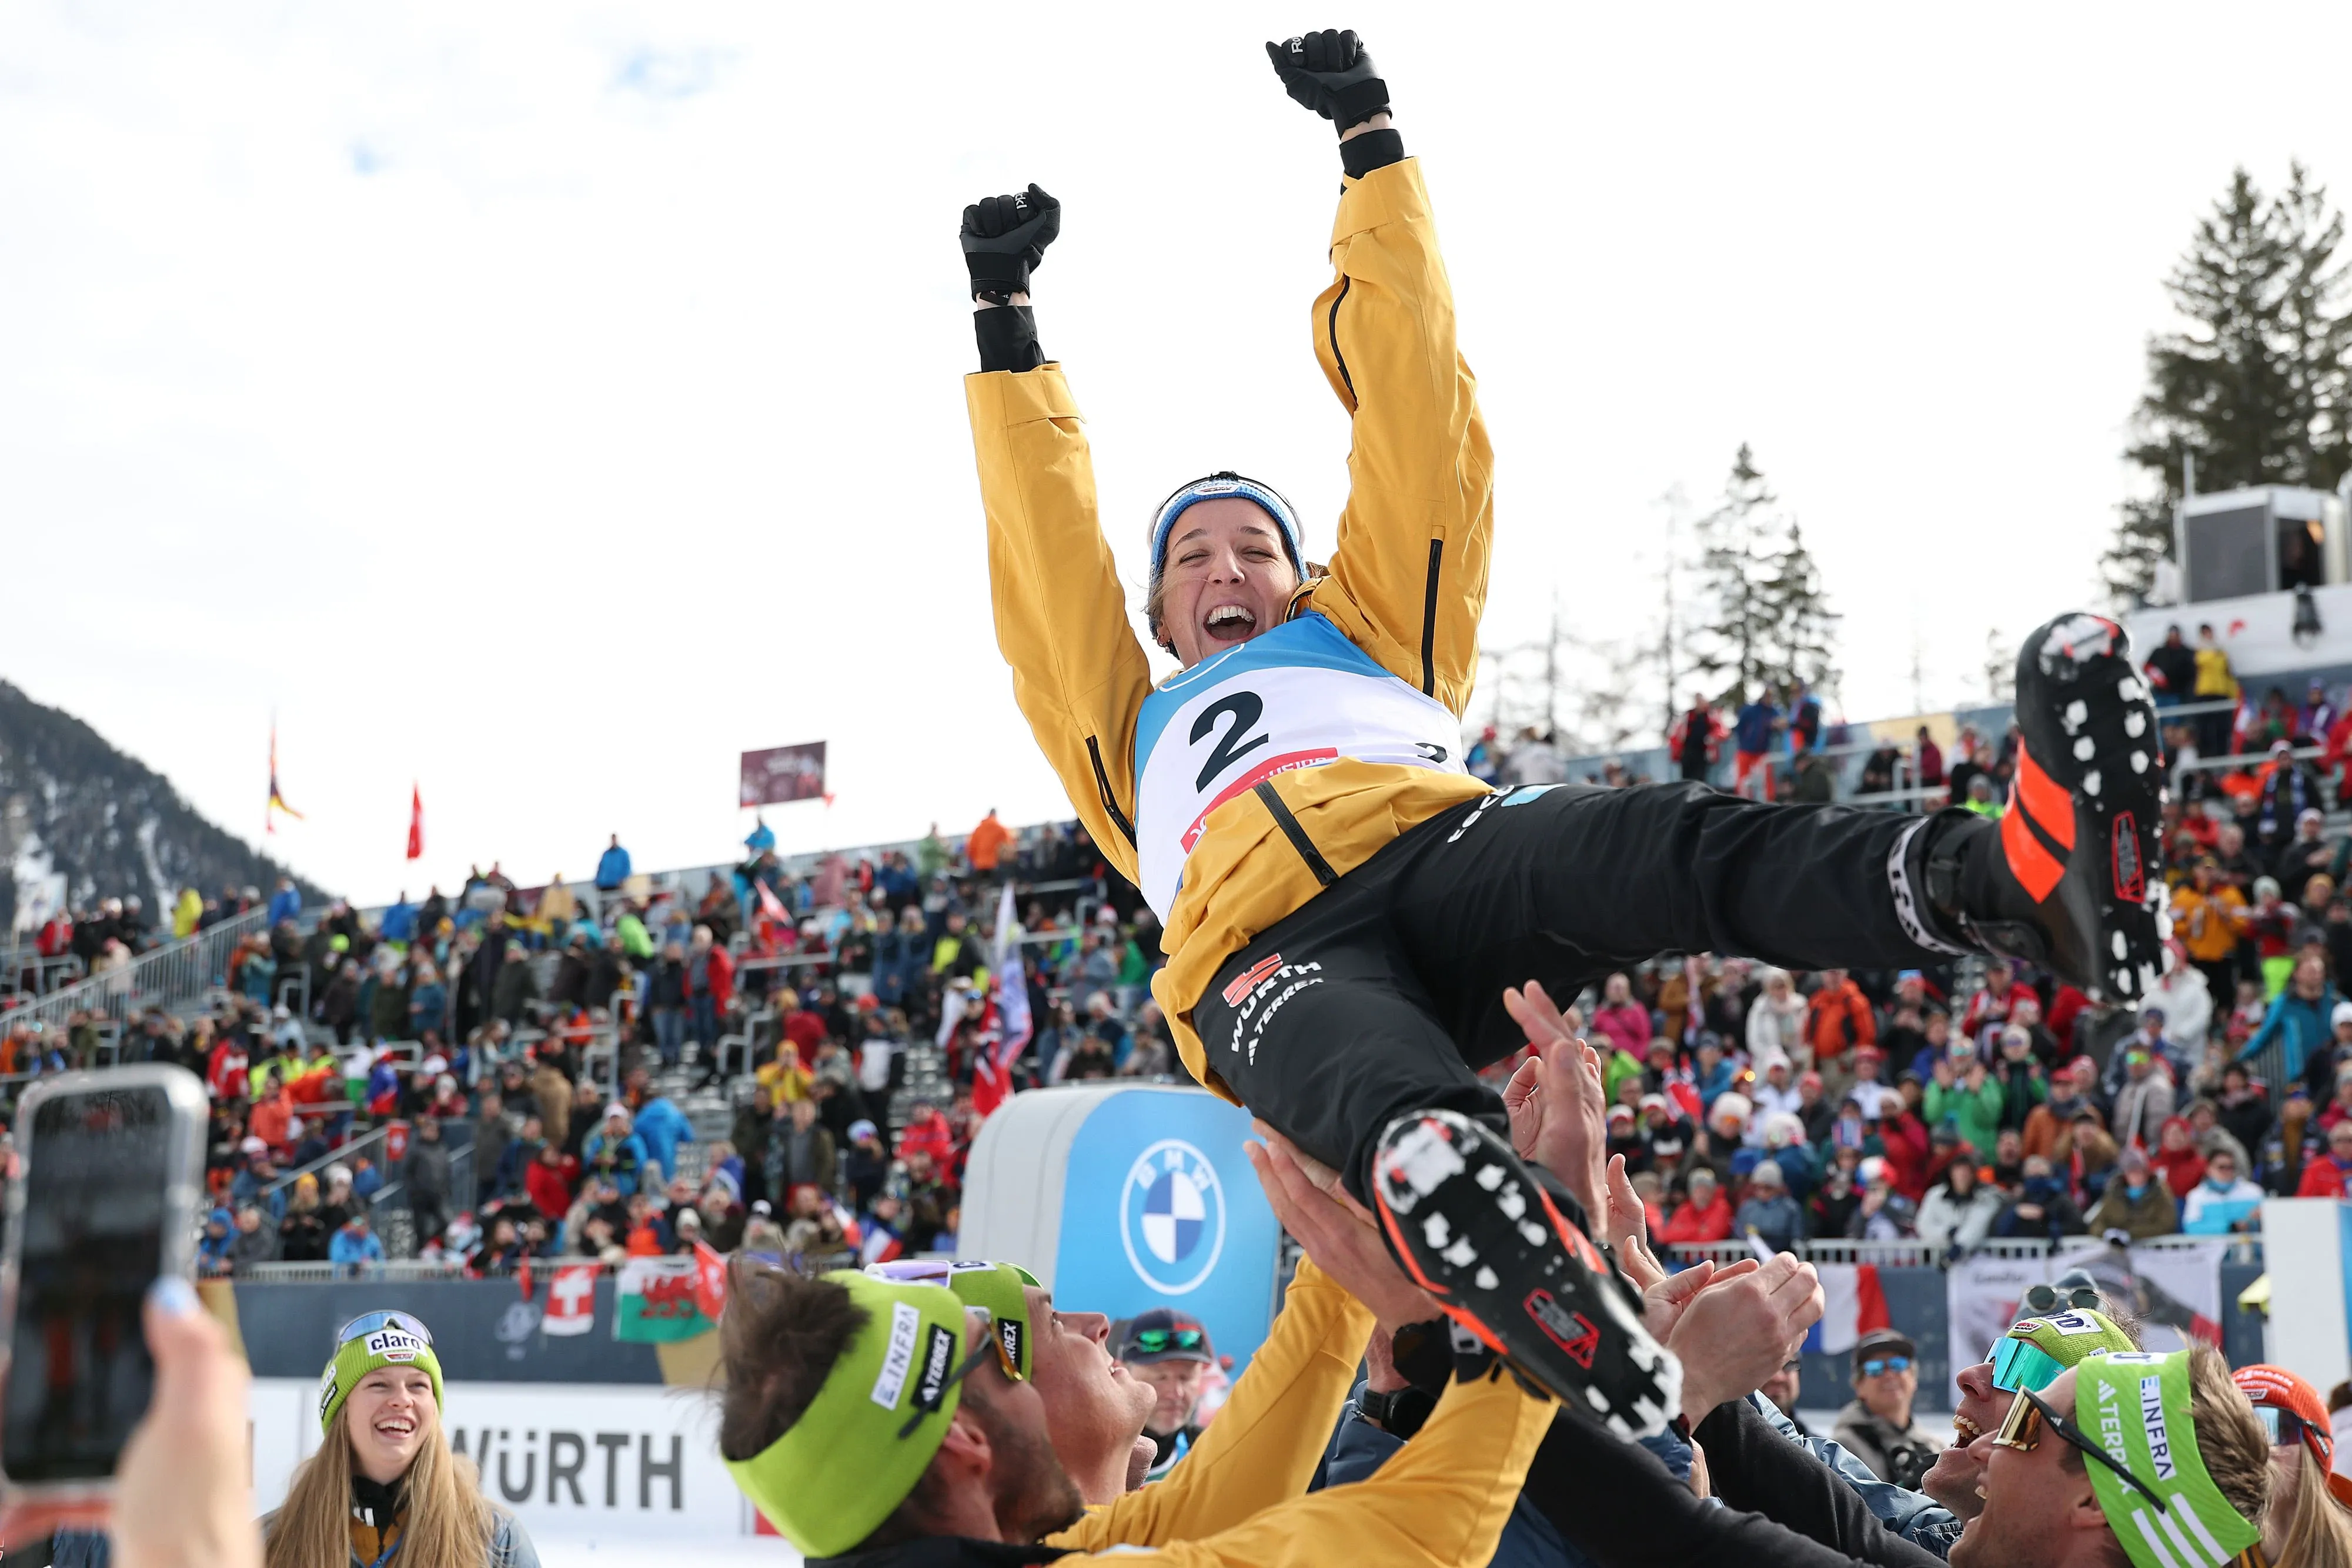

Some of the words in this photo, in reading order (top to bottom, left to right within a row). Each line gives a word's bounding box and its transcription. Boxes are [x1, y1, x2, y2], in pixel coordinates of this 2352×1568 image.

[1190, 691, 1268, 793] 2
[1254, 977, 1324, 1035] TERREX
[1135, 1148, 1212, 1192] BMW
[371, 1333, 421, 1350] claro
